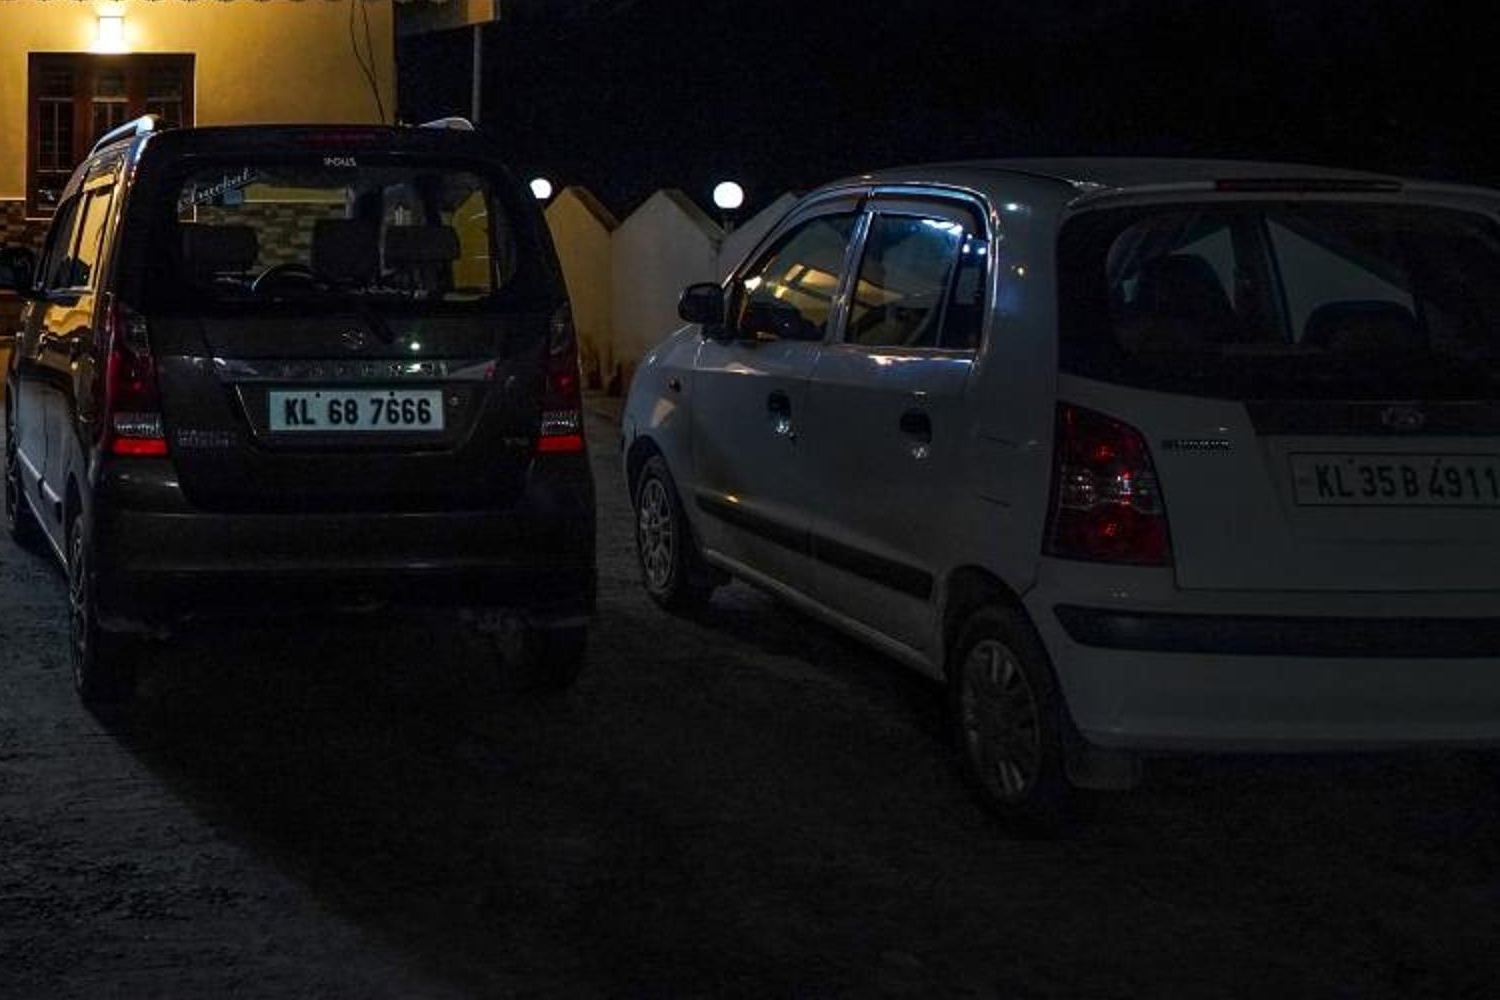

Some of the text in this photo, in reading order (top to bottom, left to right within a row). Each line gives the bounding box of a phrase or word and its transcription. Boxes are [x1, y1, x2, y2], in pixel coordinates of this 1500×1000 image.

[285, 398, 431, 425] KL 68 7666
